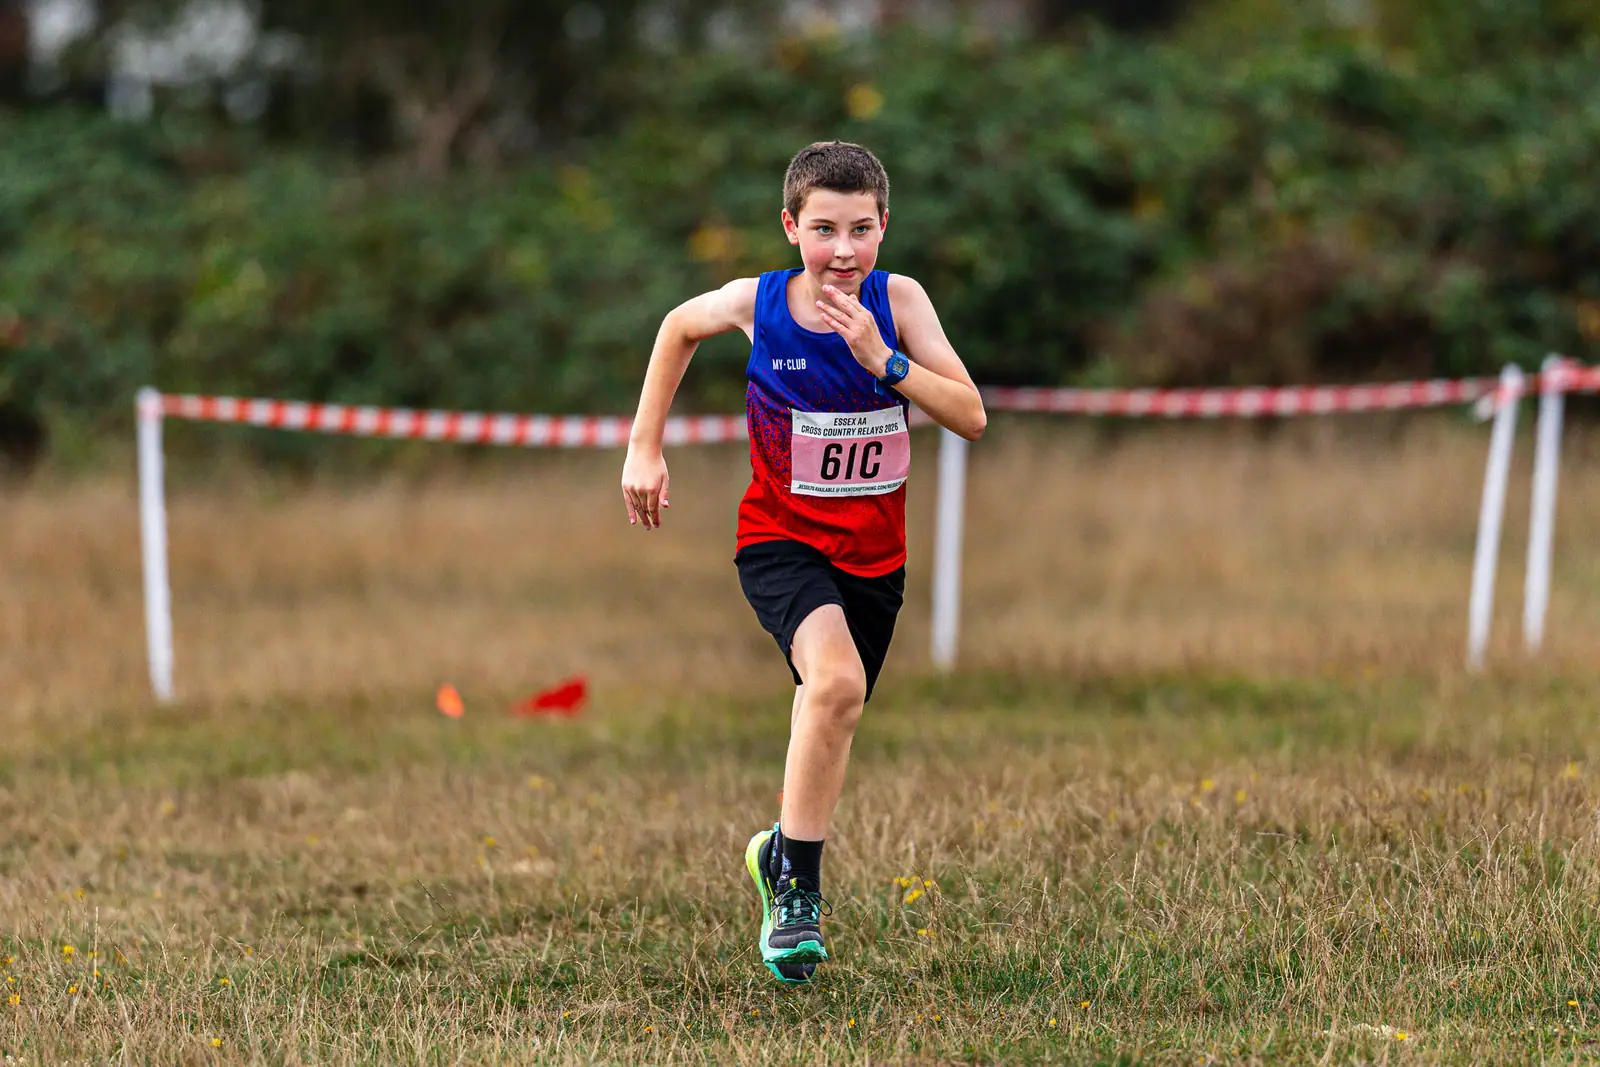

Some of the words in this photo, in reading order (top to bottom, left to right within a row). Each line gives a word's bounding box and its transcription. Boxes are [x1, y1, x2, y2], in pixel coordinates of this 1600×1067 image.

[834, 417, 856, 426] ESSEX
[857, 417, 867, 425] AA
[801, 425, 822, 436] CROSS
[823, 428, 855, 437] COUNTRY
[857, 425, 883, 436] RELAYS
[884, 422, 899, 434] 2026
